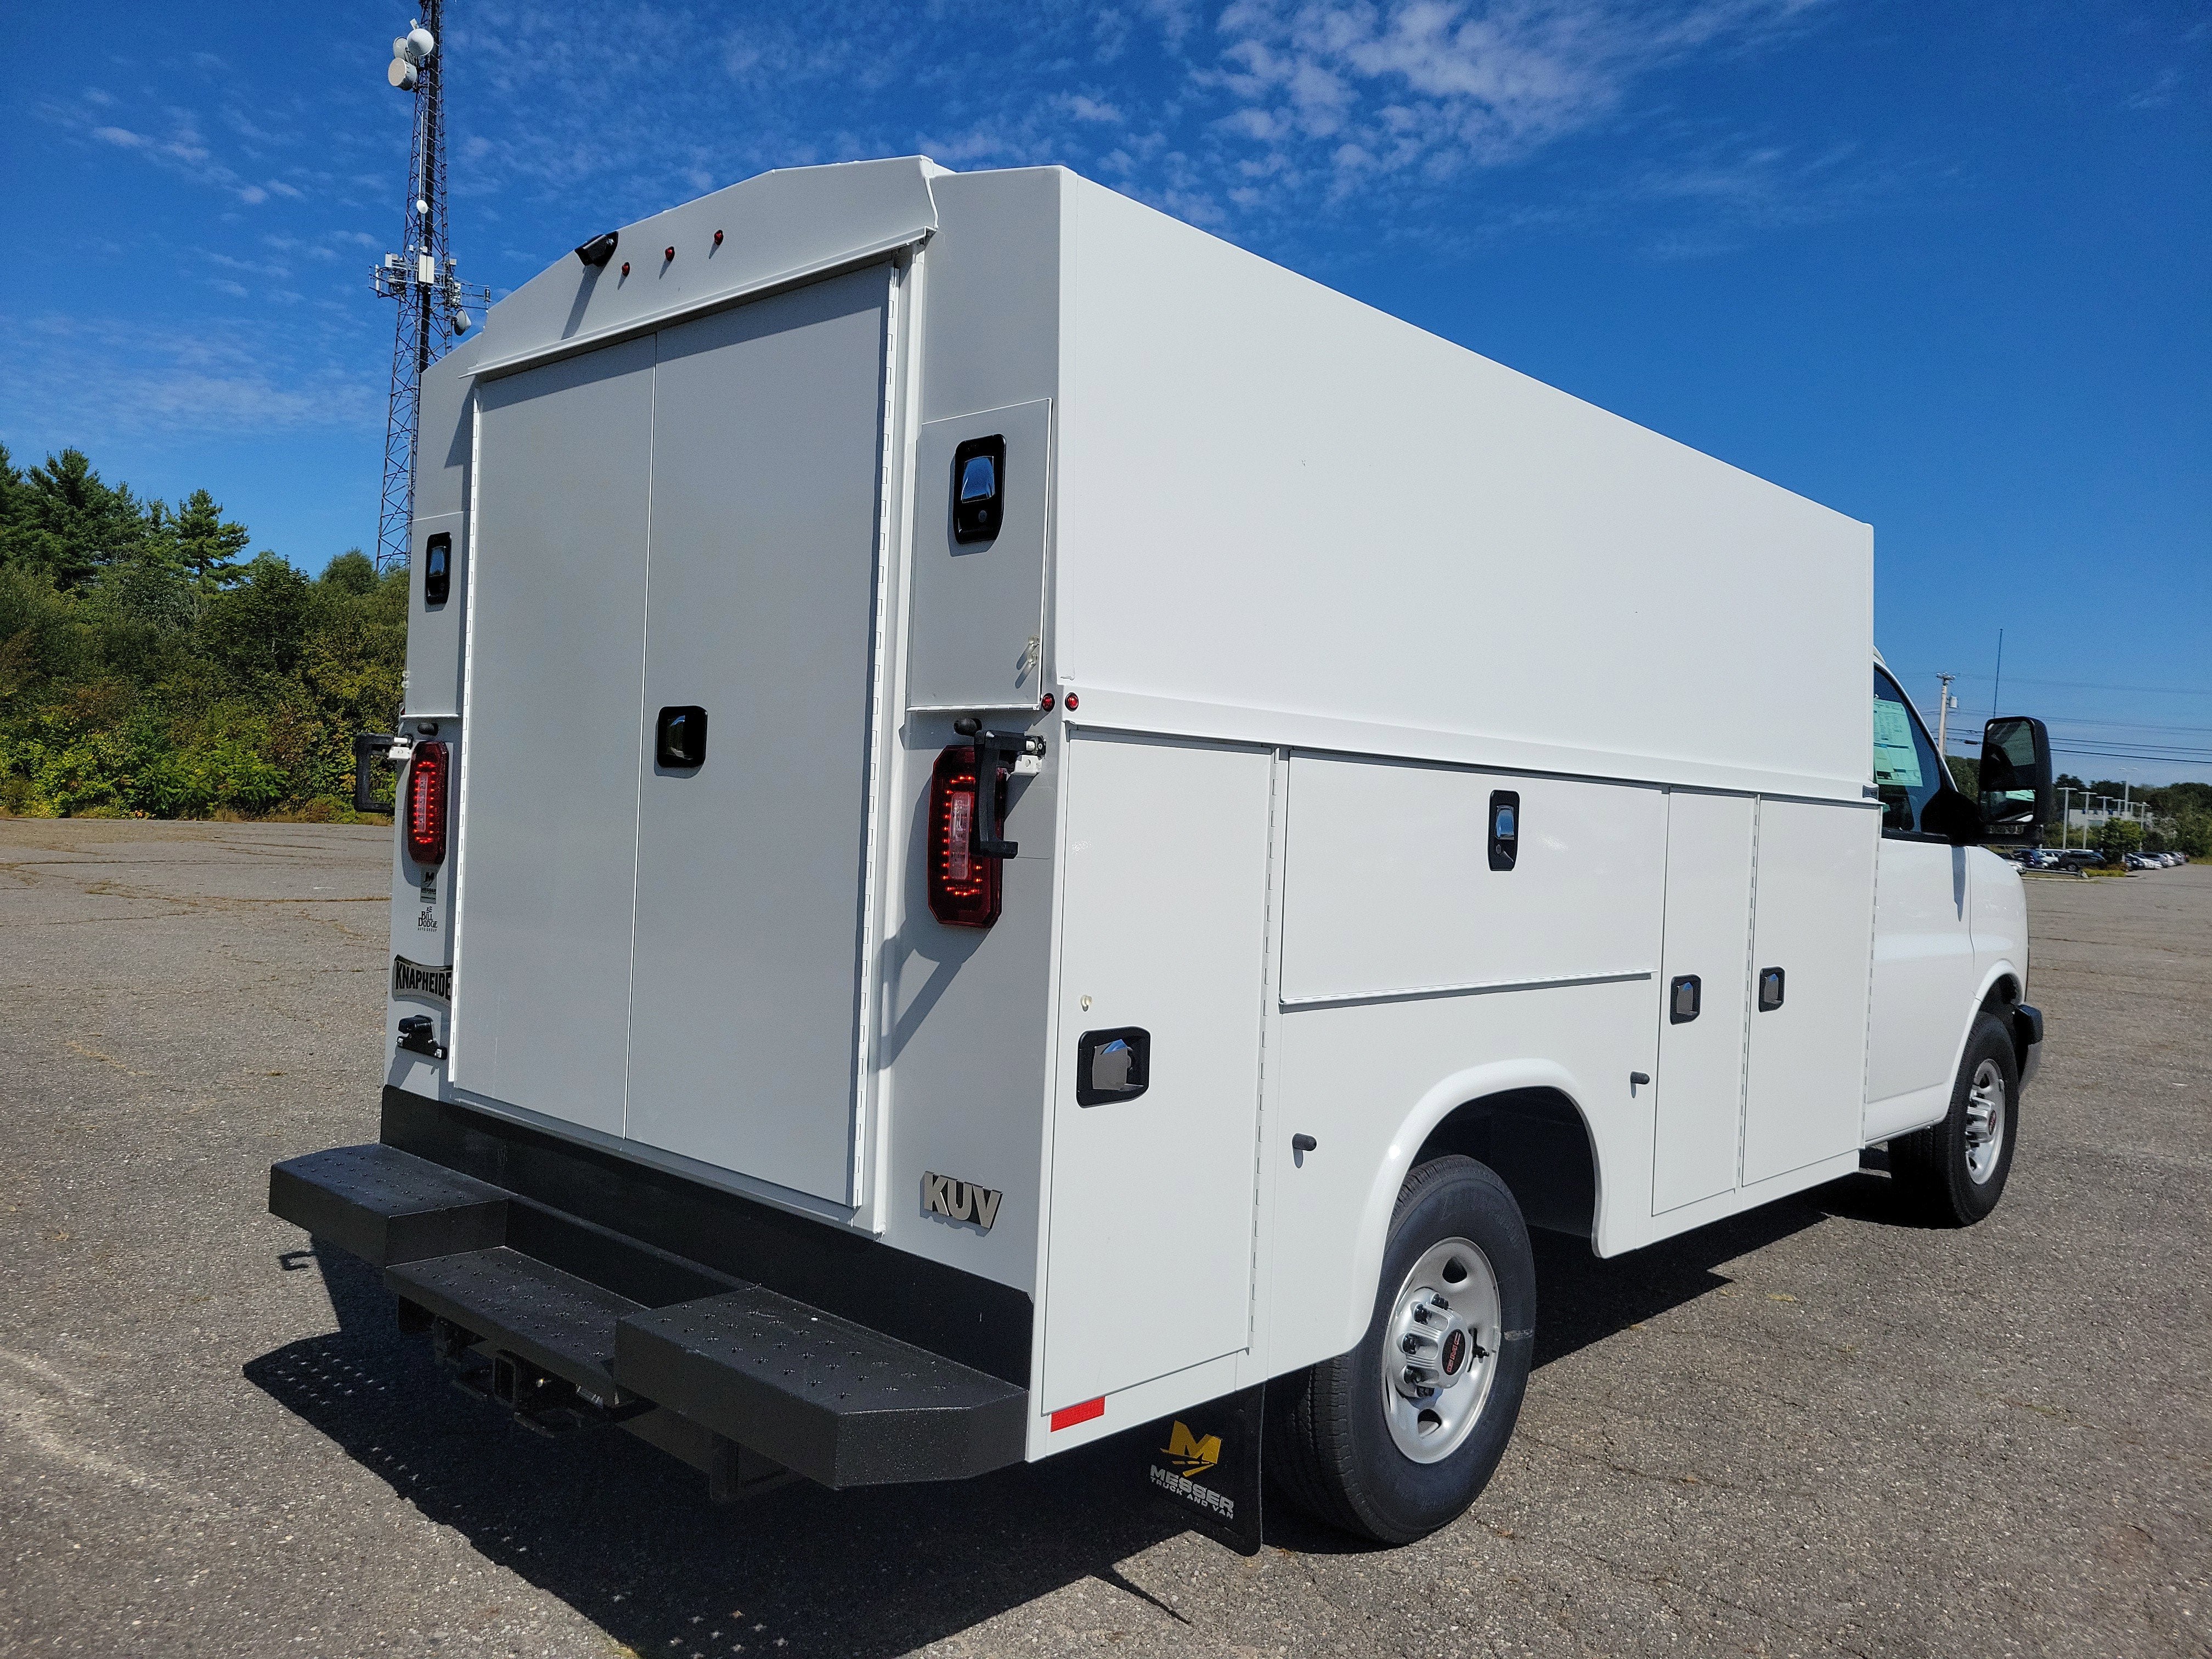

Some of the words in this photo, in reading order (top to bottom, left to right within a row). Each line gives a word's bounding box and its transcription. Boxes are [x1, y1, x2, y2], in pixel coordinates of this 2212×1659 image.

[418, 917, 438, 928] DODGE
[421, 911, 433, 921] BILL
[396, 961, 452, 1001] KNAPHEIDE
[924, 1171, 1003, 1229] KUV
[1150, 1464, 1234, 1513] MESSER
[1150, 1476, 1183, 1496] TRUCK
[1187, 1493, 1208, 1507] AND
[1212, 1504, 1234, 1519] VAN
